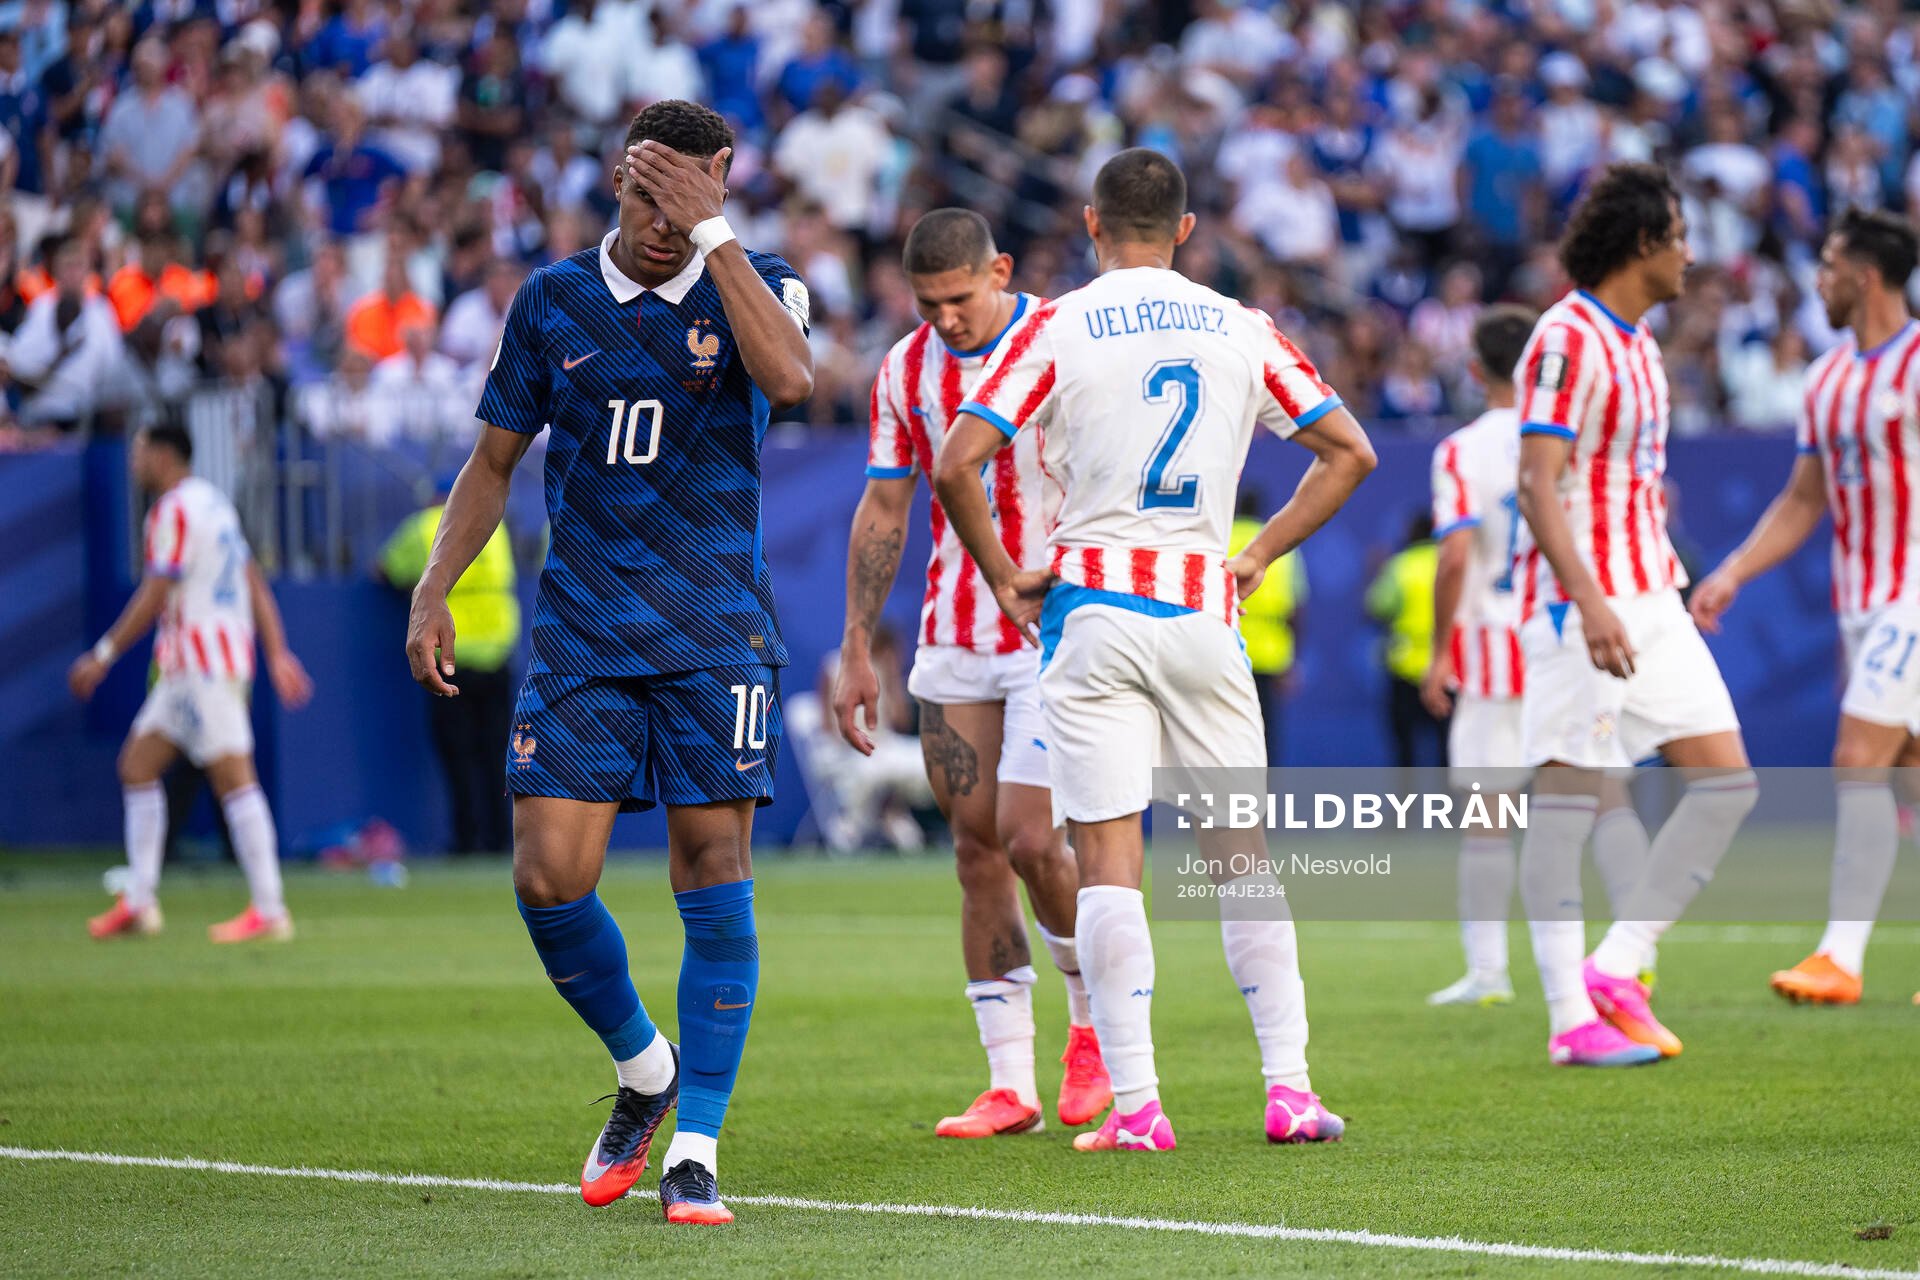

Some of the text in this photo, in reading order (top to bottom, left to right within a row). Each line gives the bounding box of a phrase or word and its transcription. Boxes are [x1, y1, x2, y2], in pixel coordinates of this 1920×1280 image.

[1085, 297, 1228, 339] VELÁZQUEZ
[607, 399, 664, 465] 10
[1137, 358, 1206, 516] 2
[1865, 624, 1918, 678] 21
[730, 684, 767, 750] 10
